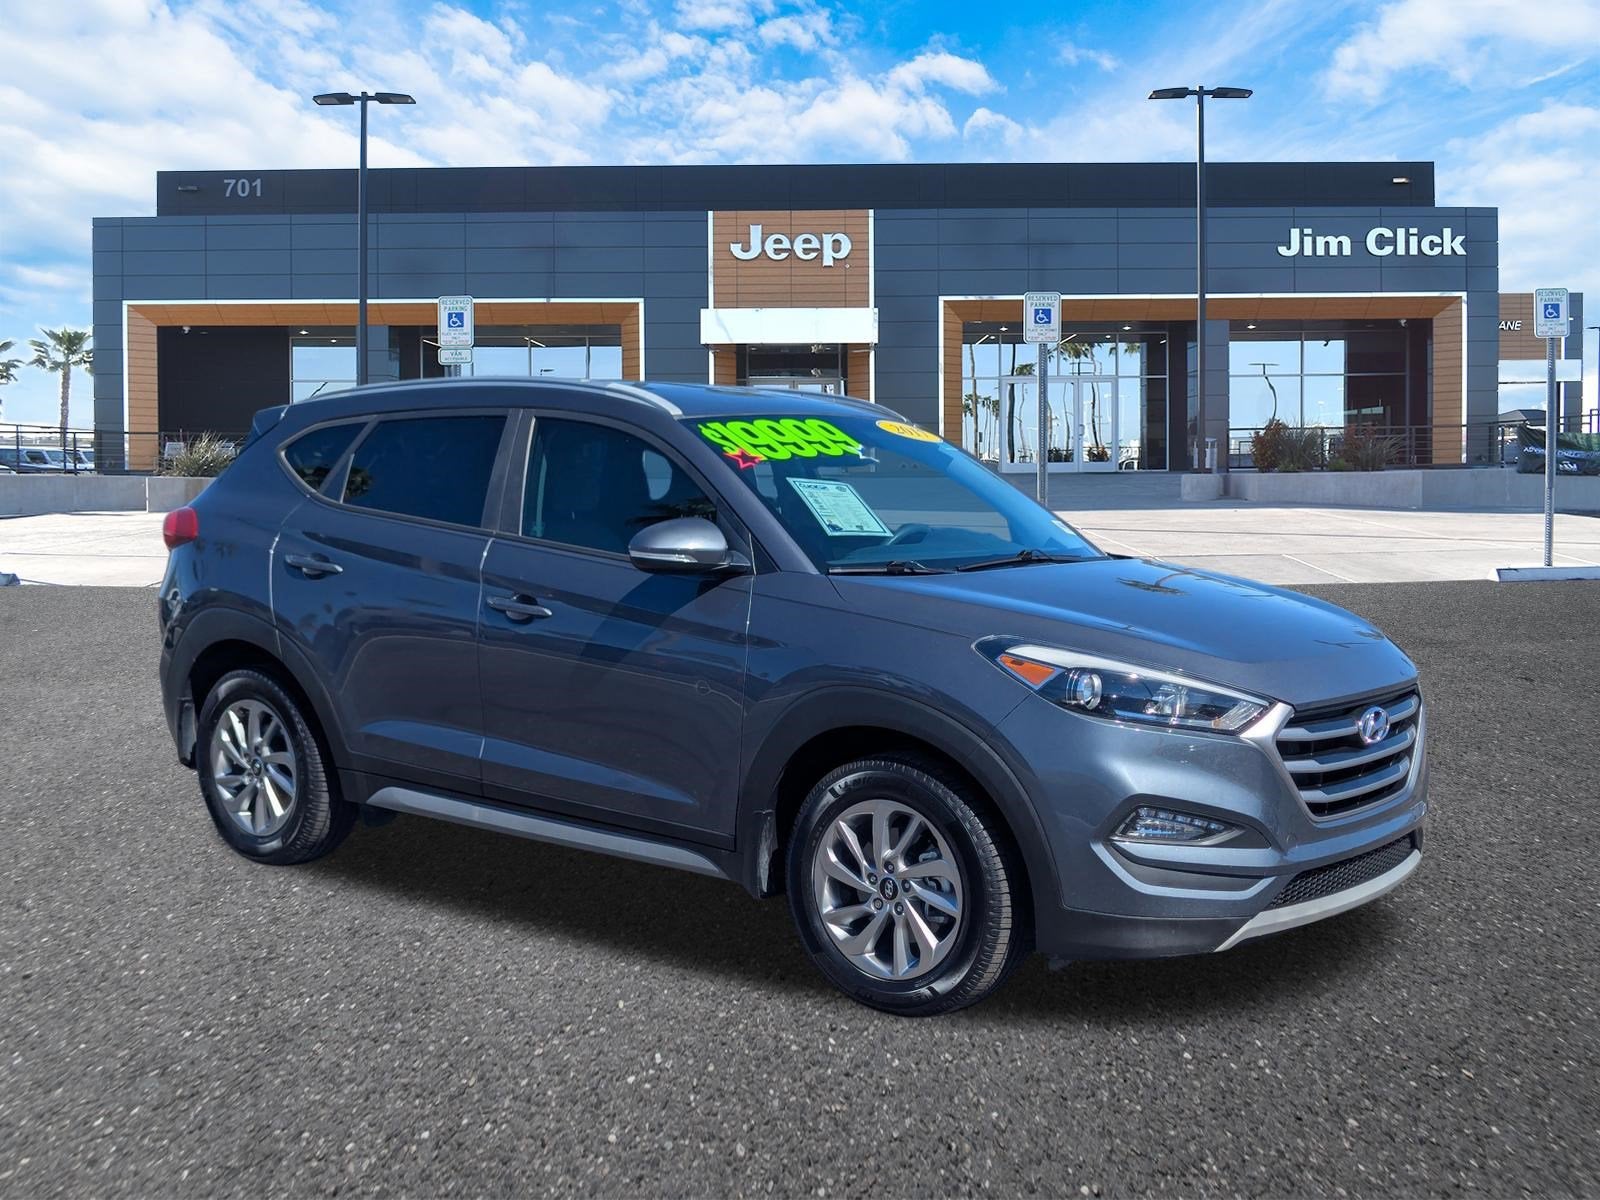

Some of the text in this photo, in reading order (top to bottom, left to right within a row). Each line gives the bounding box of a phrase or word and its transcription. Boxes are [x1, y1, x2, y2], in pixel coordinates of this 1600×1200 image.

[223, 178, 261, 197] 701
[730, 224, 851, 266] Jeep
[1277, 227, 1467, 256] Jim Click
